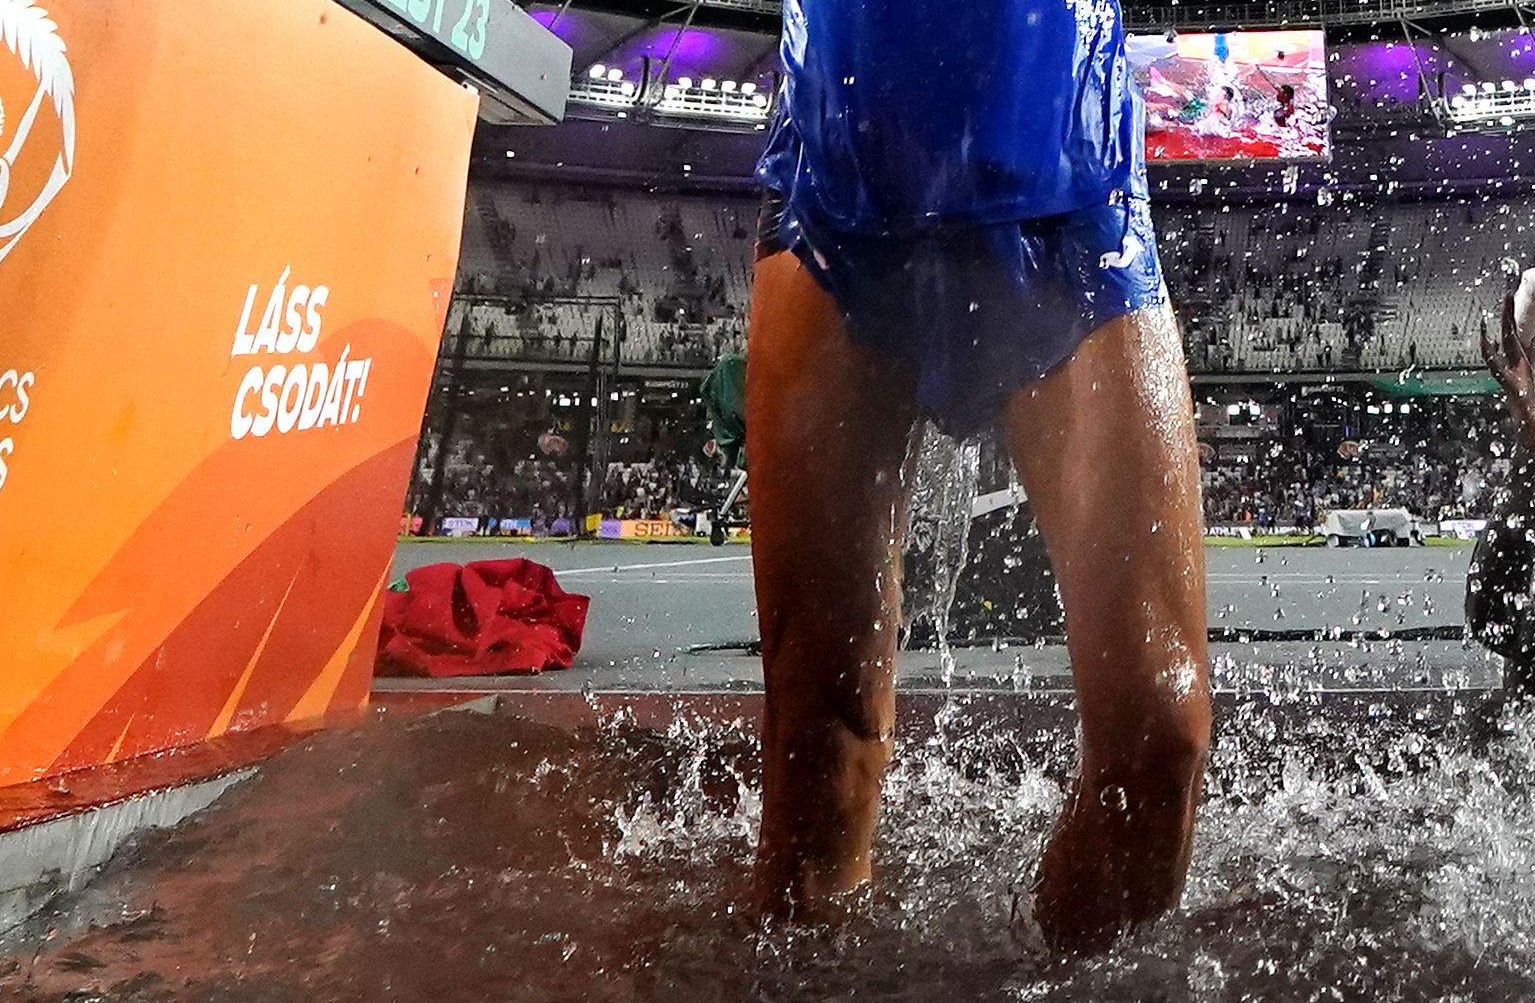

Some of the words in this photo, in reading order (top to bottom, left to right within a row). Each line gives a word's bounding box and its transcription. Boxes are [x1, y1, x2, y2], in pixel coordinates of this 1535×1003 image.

[231, 265, 330, 357] LÁSS
[230, 344, 372, 439] CSODÁT!
[634, 522, 673, 537] SEI
